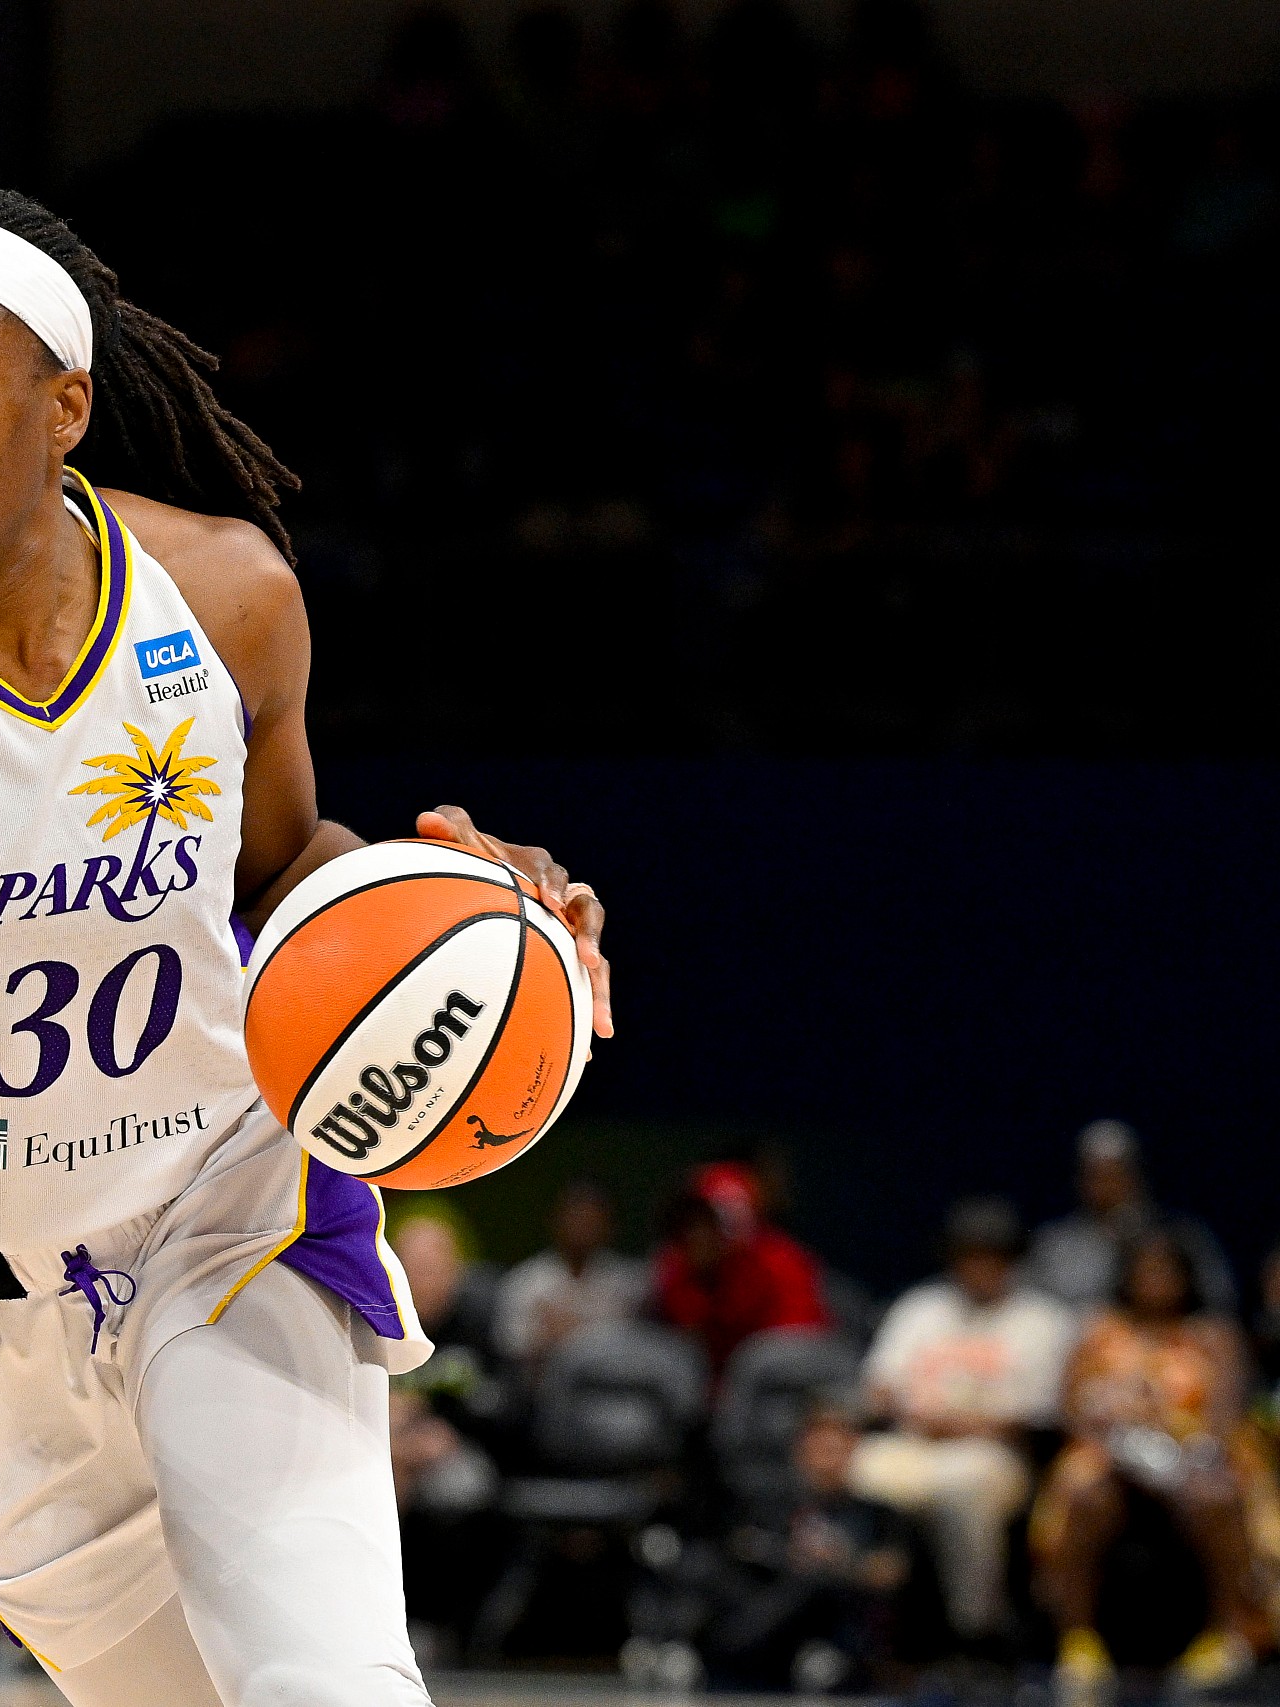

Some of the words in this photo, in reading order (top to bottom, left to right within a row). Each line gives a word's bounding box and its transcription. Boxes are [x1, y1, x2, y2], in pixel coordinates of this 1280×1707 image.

[146, 641, 194, 668] UCLA
[309, 989, 487, 1160] Wilson
[22, 1102, 210, 1172] EquiTrust
[407, 1111, 427, 1131] EVO
[425, 1086, 445, 1109] NXT
